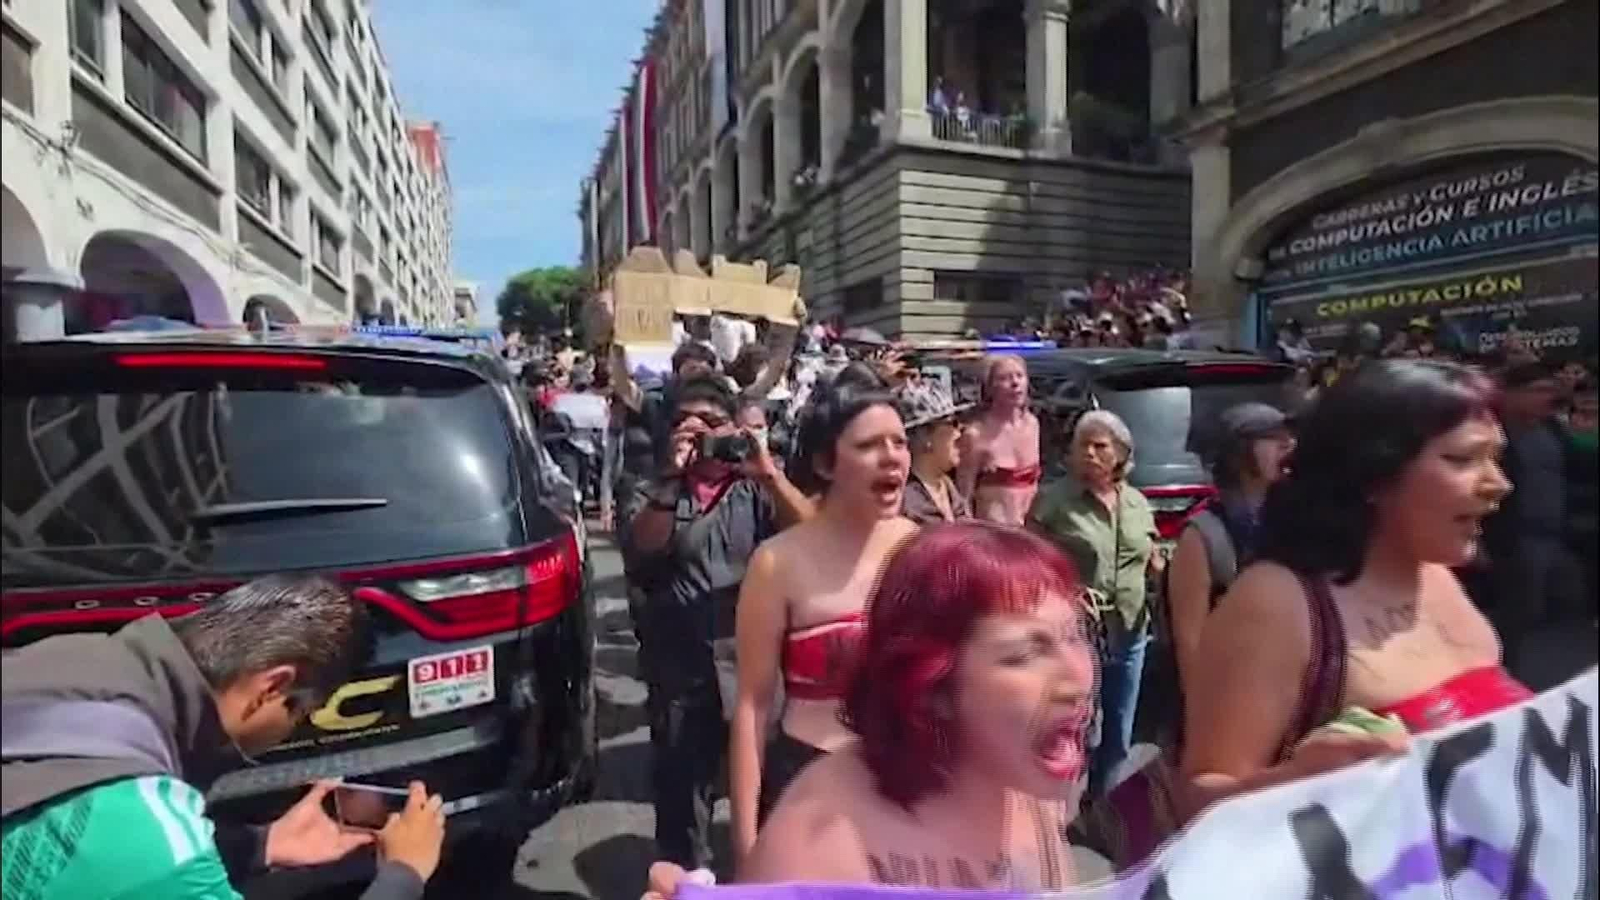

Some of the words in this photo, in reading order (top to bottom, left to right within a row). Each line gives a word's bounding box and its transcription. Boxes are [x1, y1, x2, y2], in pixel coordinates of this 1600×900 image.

[1430, 164, 1525, 200] CURSOS
[1289, 203, 1453, 255] COMPUTACIÓN
[1463, 197, 1480, 217] E
[1488, 168, 1597, 212] INGLÉS
[1295, 233, 1443, 274] INTELIGENCIA
[1451, 203, 1596, 247] ARTIFICIA
[1317, 275, 1522, 316] COMPUTACIÓN
[416, 653, 484, 682] 911
